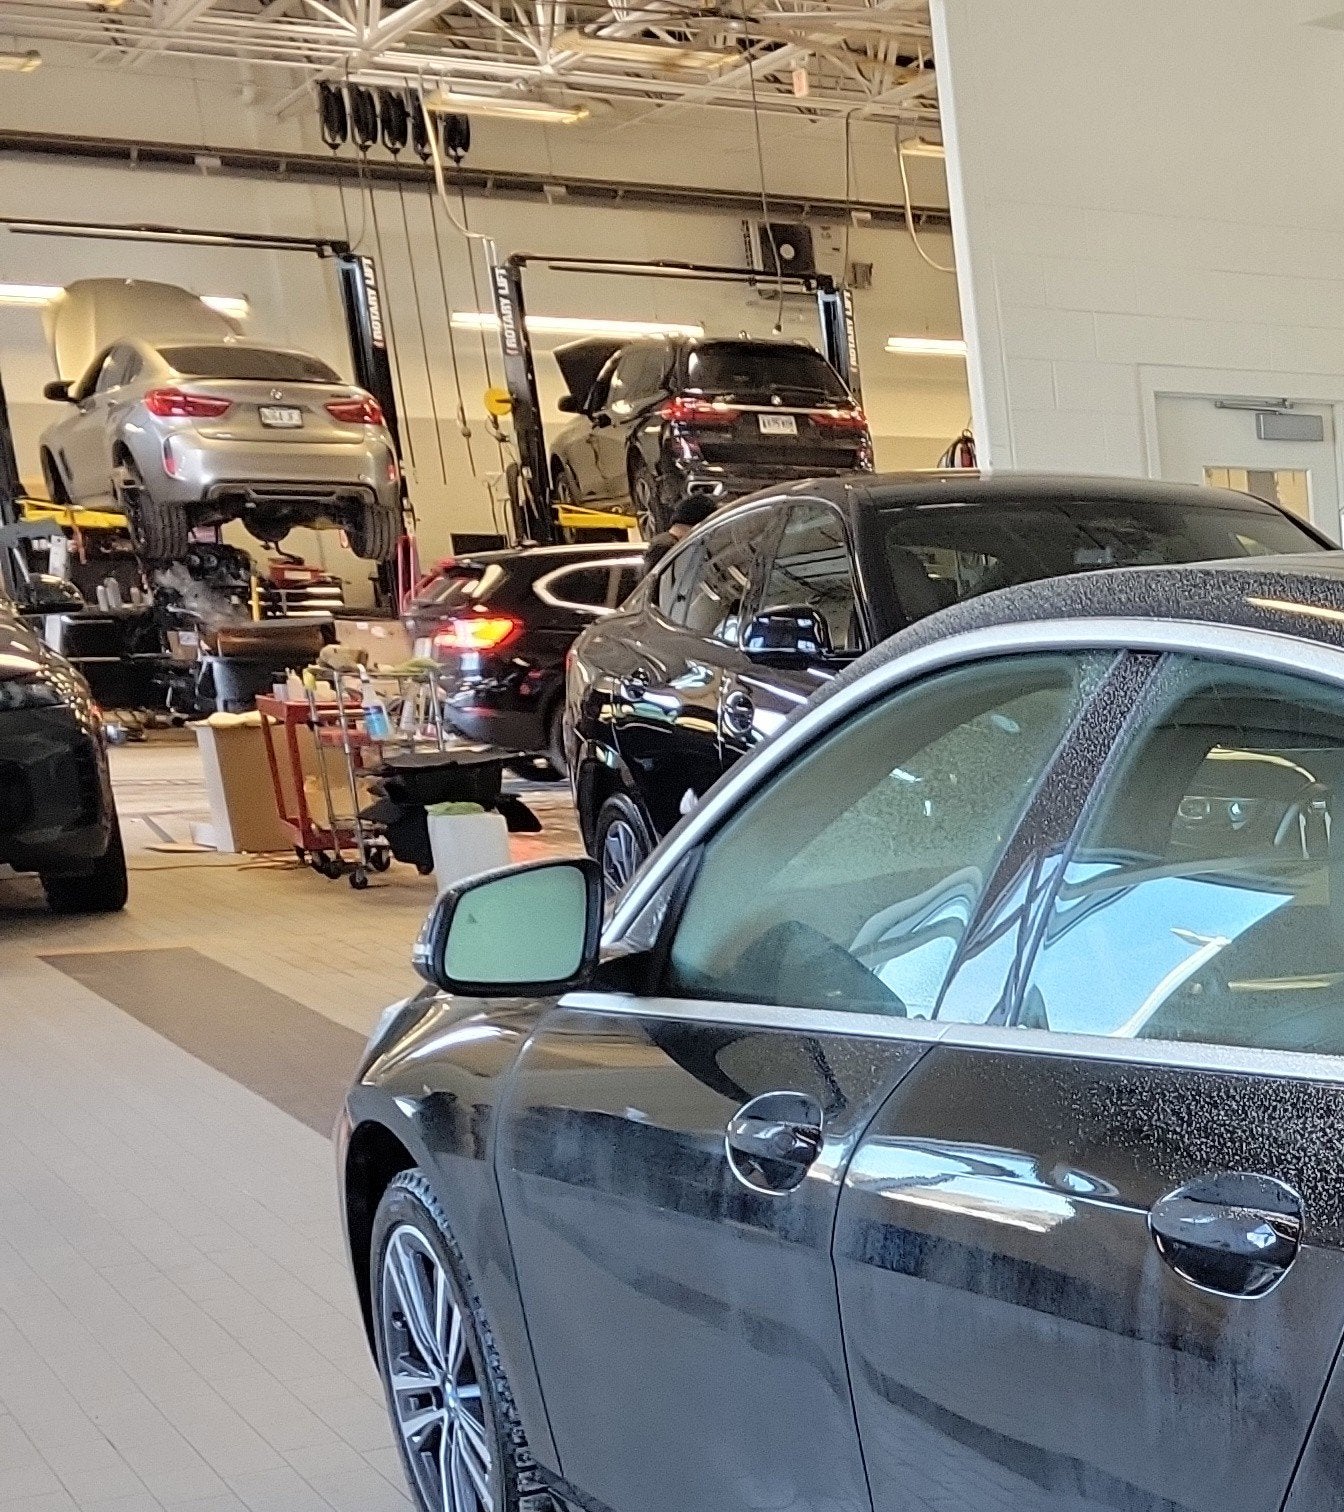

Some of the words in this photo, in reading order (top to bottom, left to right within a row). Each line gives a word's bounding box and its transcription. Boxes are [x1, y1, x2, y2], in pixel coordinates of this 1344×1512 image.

[362, 257, 376, 286] LIFT
[495, 268, 509, 295] LIFT
[366, 289, 385, 341] ROTARY
[499, 297, 518, 348] ROTARY
